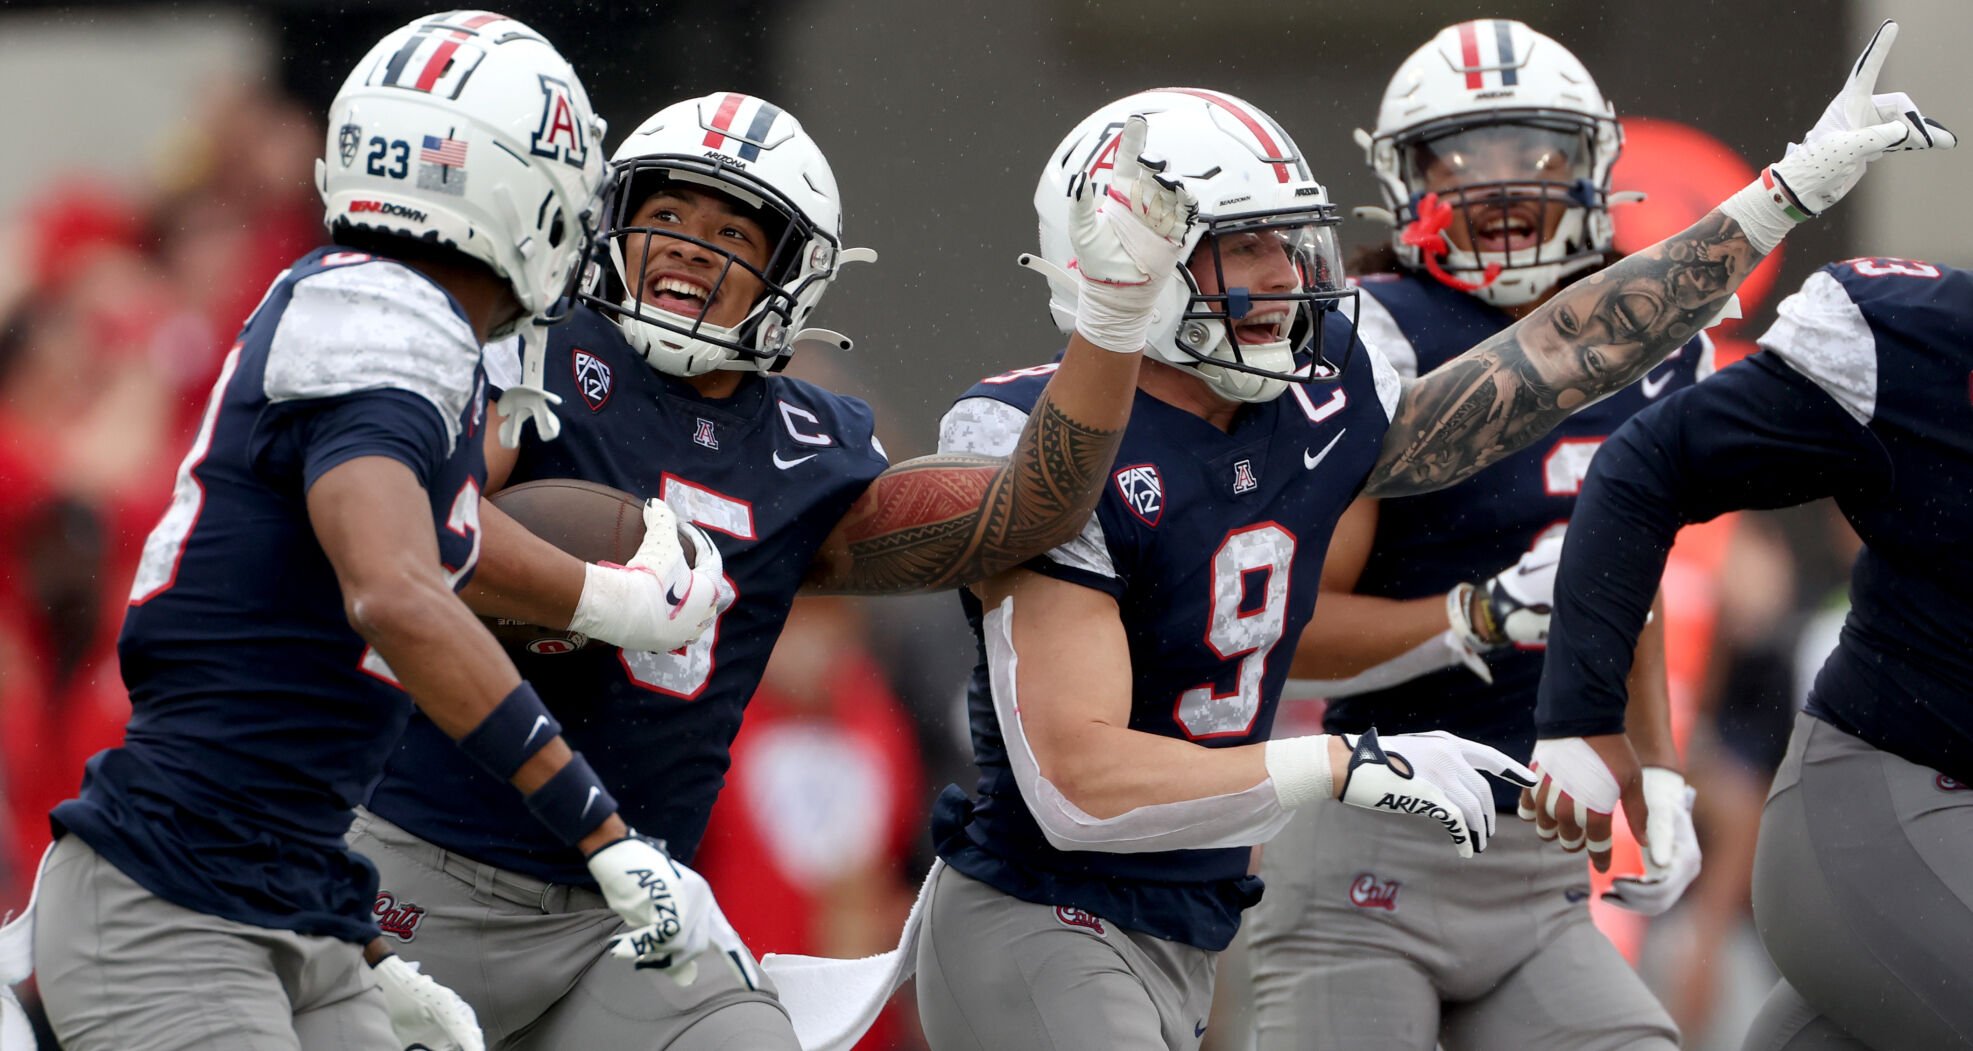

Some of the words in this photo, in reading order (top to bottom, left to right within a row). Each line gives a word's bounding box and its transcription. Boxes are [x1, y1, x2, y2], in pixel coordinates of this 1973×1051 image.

[530, 73, 588, 169] A
[367, 136, 410, 180] 23
[703, 150, 747, 171] ARIZONA
[584, 377, 603, 401] 12
[693, 417, 719, 450] A
[1233, 459, 1258, 494] A
[1134, 489, 1160, 515] 12
[1173, 520, 1297, 740] 9
[1374, 792, 1467, 845] ARIZONA
[372, 890, 425, 940] Cats
[625, 868, 681, 957] ARIZONA
